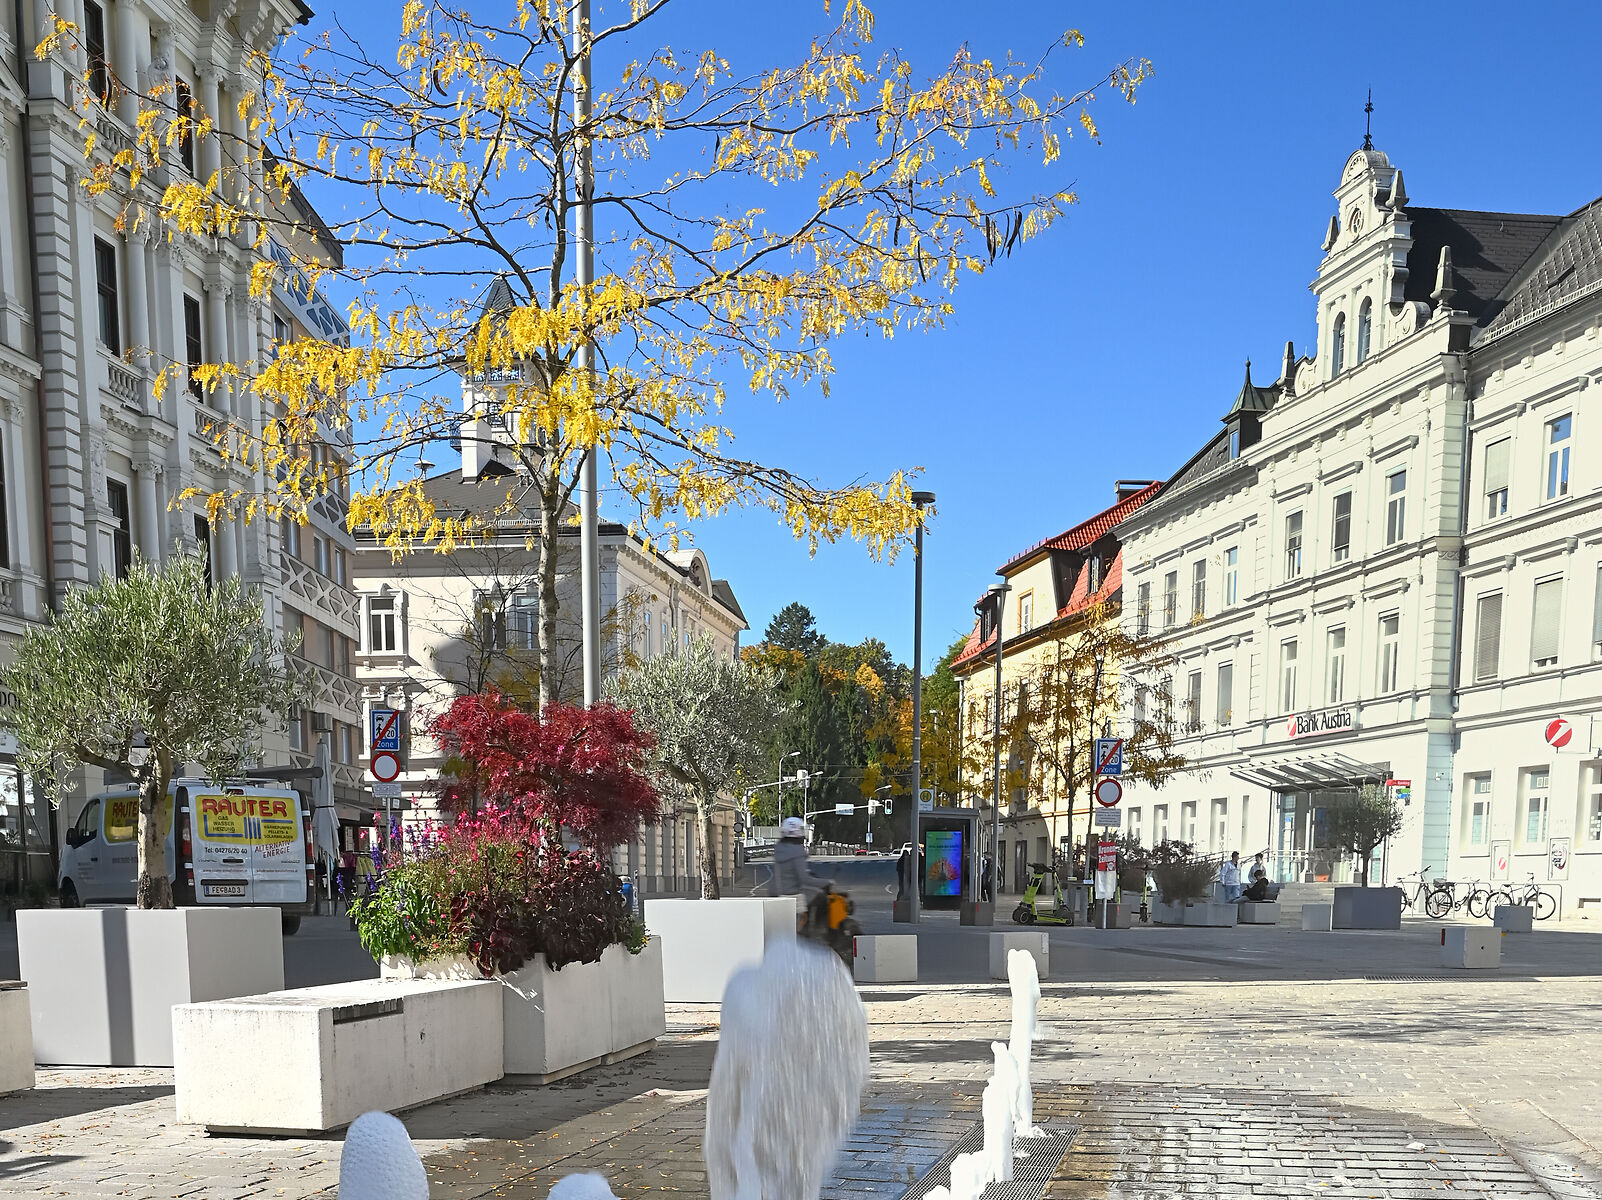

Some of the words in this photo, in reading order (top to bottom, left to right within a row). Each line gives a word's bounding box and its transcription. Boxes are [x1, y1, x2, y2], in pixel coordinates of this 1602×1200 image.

[1296, 714, 1319, 734] Bank
[1320, 707, 1351, 730] Austria
[387, 730, 395, 738] 20
[112, 801, 139, 818] RAUTE
[202, 798, 287, 817] RAUTER
[263, 846, 290, 858] ENERGIE
